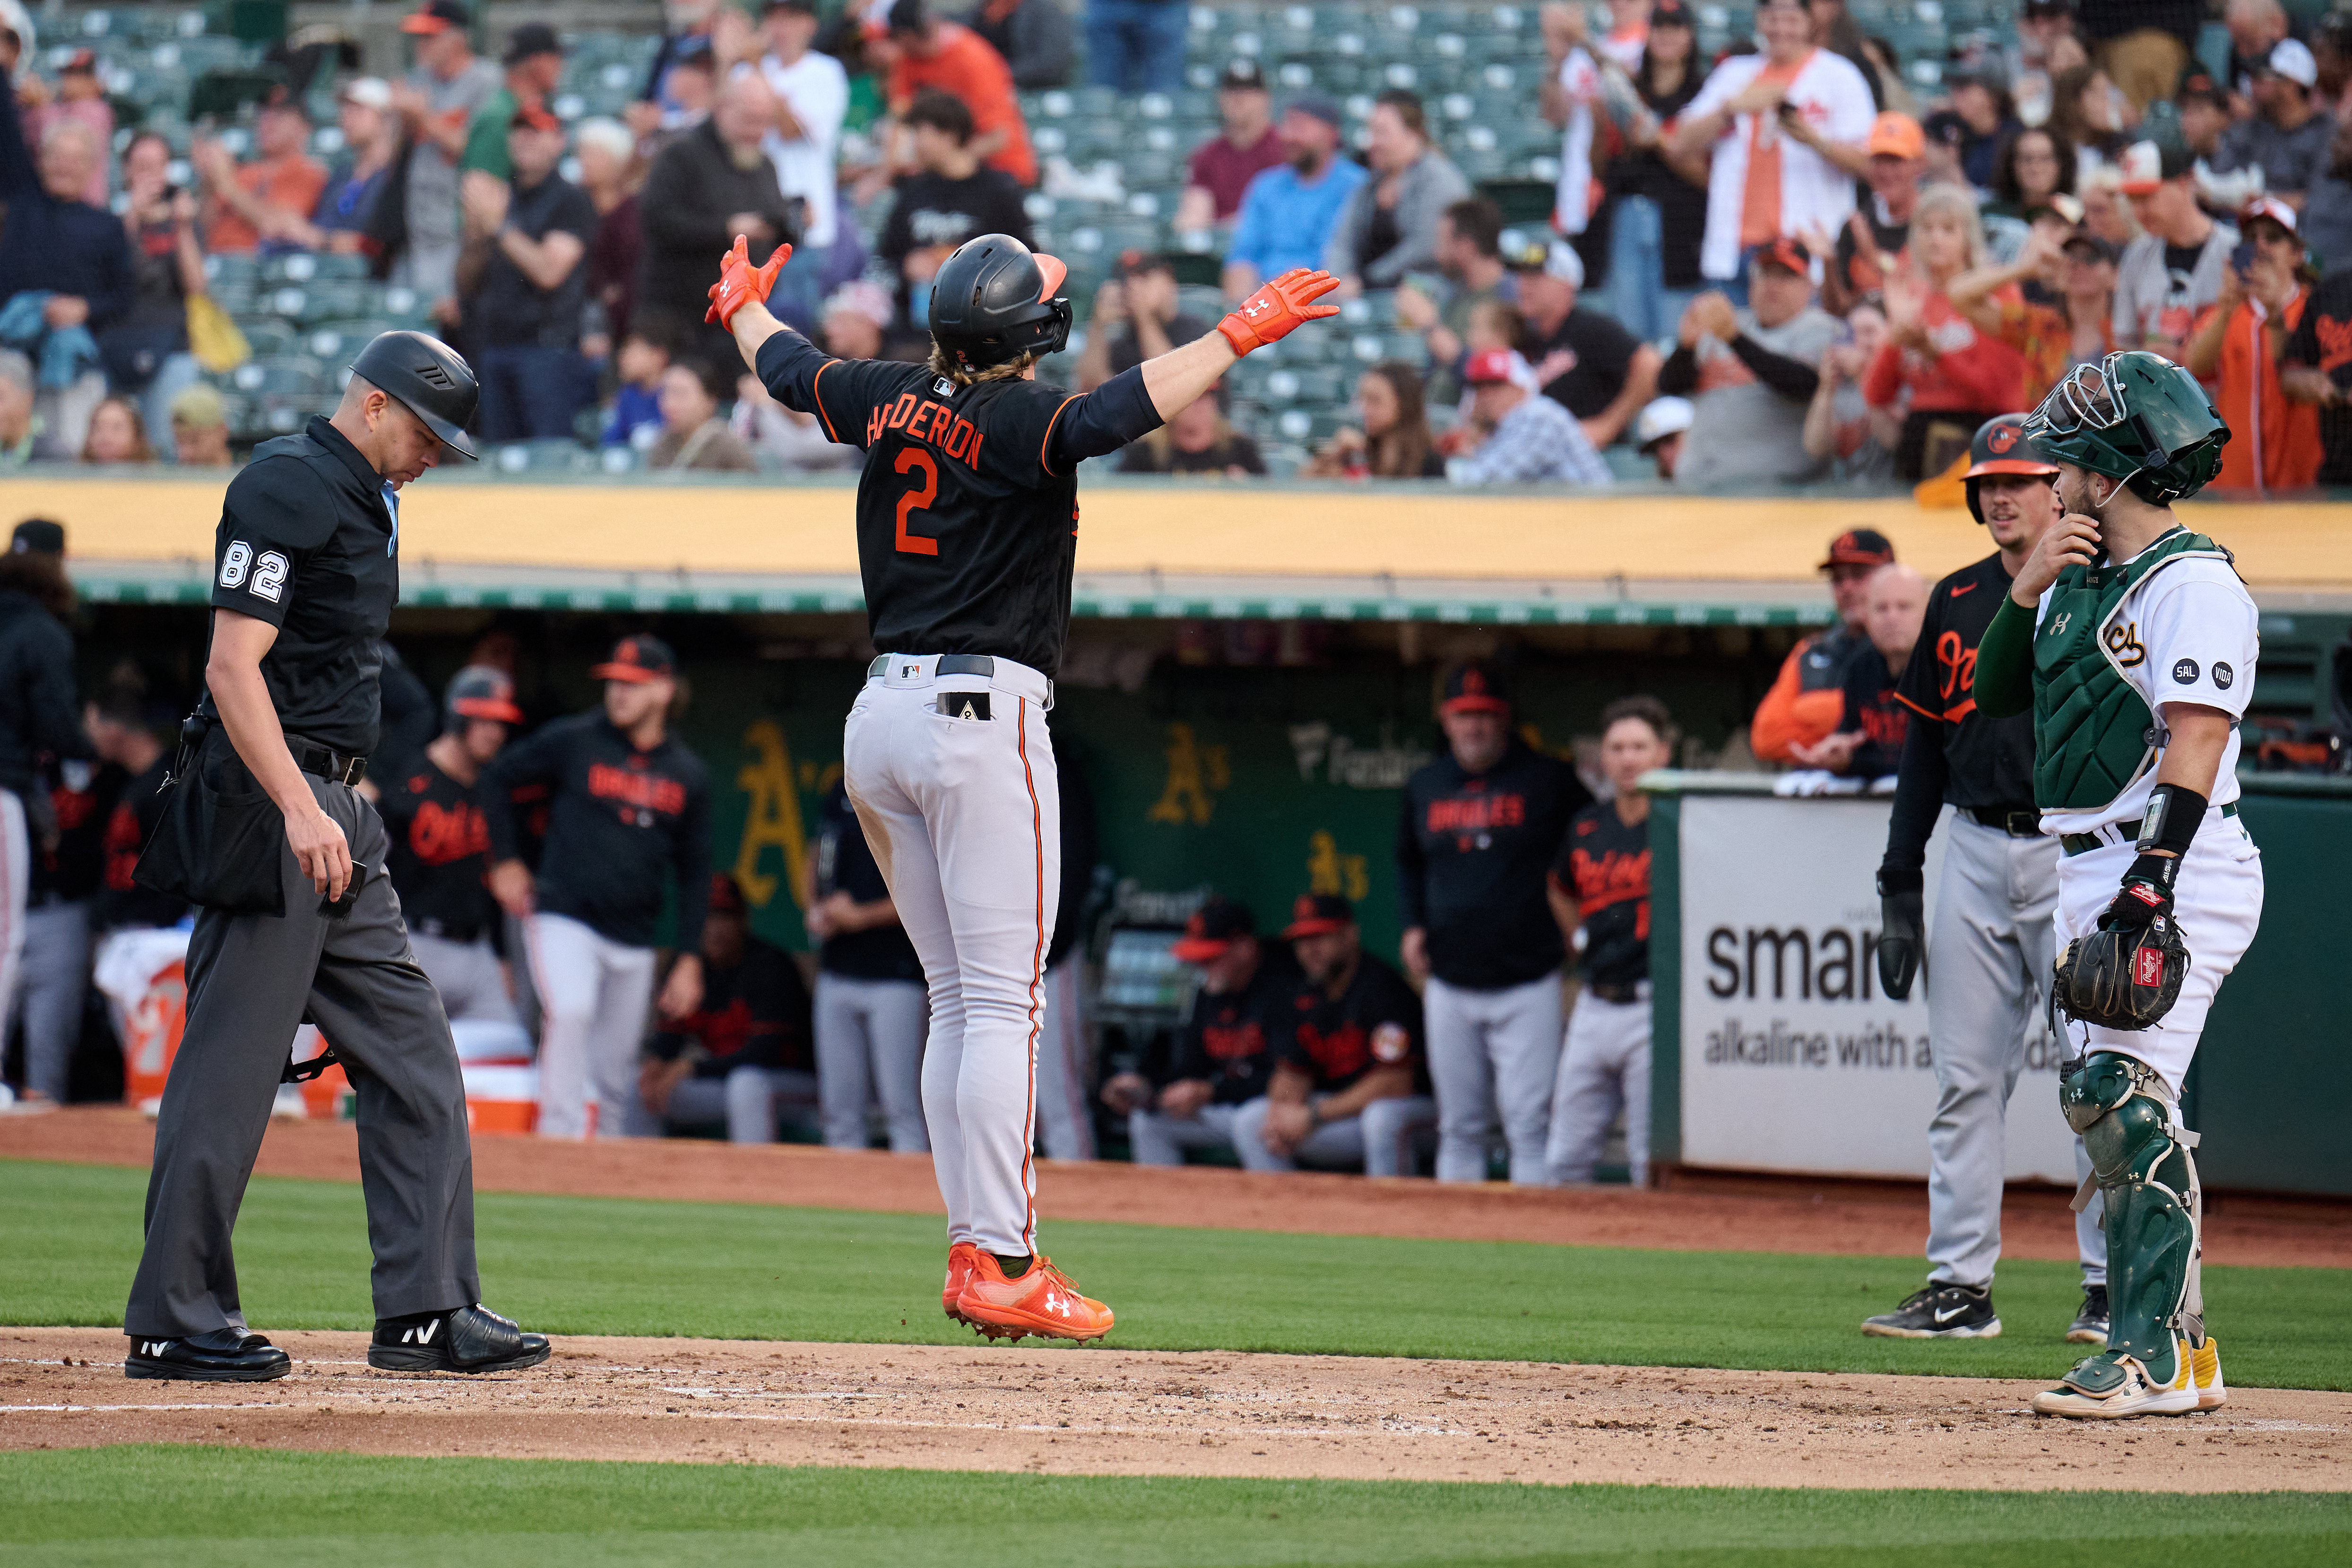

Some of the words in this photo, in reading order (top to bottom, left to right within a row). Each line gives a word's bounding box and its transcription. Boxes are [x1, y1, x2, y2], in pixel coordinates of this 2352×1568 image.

[956, 350, 968, 363] 2
[867, 393, 984, 470] HEDERON
[894, 447, 938, 556] 2
[219, 540, 289, 603] 82
[2177, 666, 2196, 677] SAL
[2215, 667, 2231, 684] VIDA
[2143, 951, 2154, 982] Rawlings
[1704, 1018, 1828, 1066] alkaline
[1836, 1020, 1907, 1066] with
